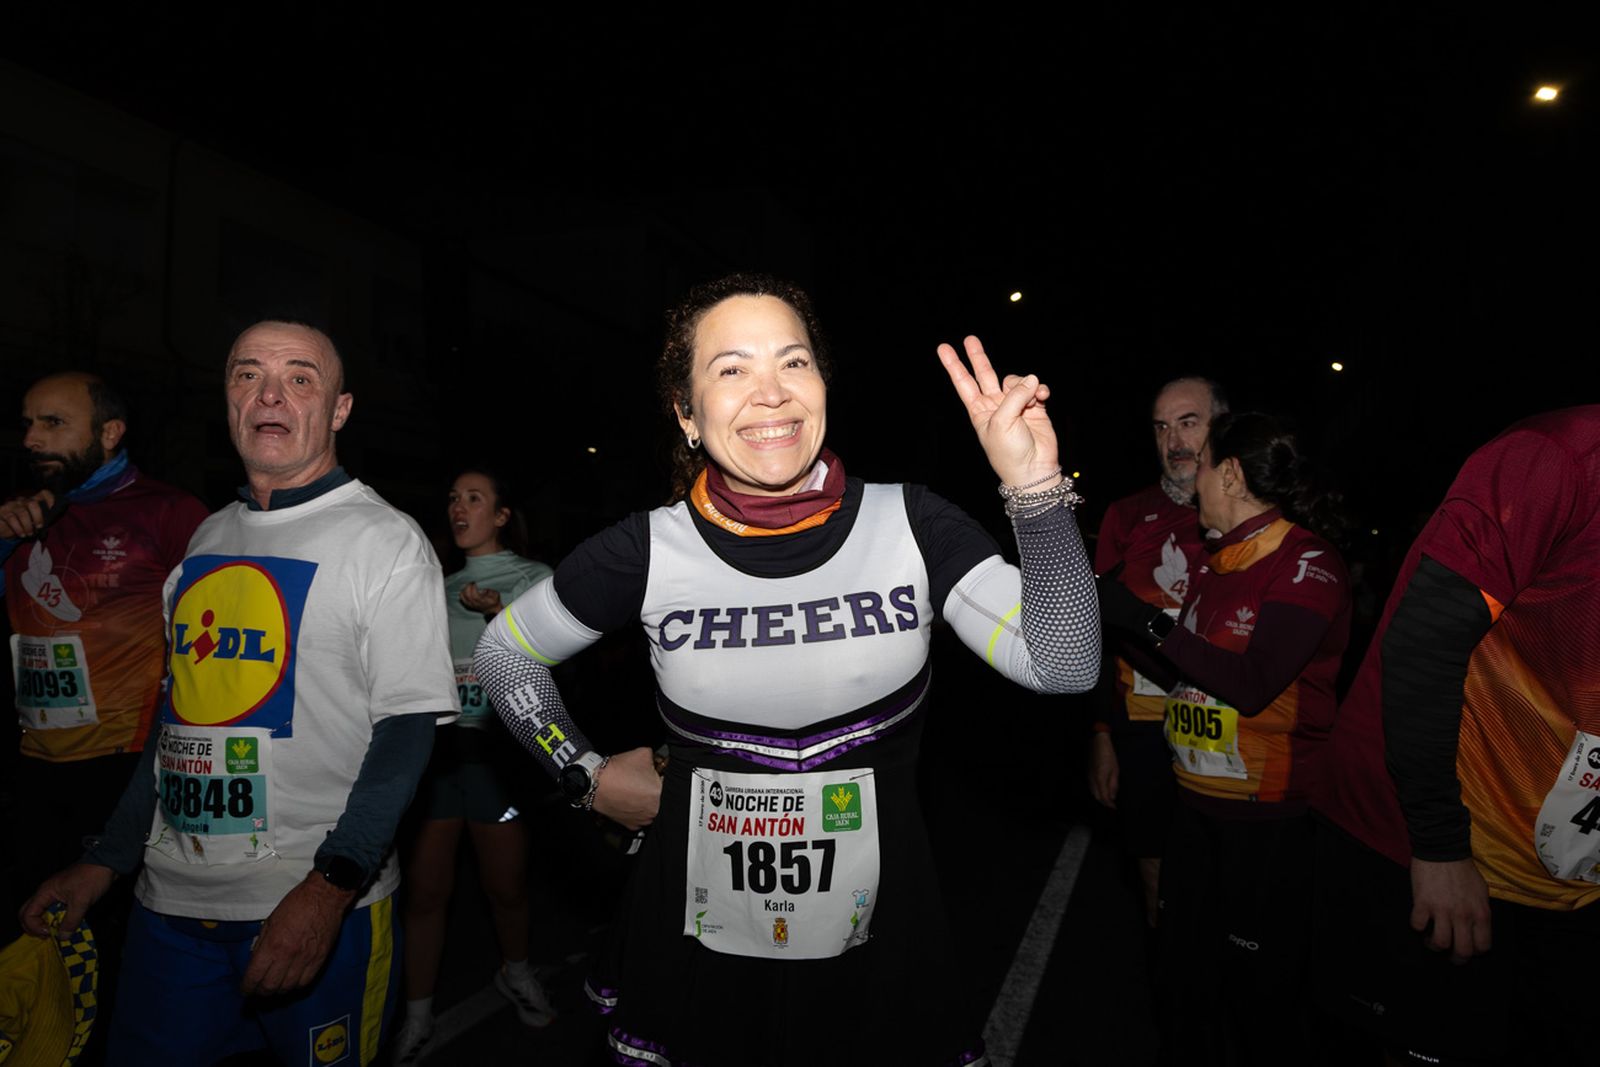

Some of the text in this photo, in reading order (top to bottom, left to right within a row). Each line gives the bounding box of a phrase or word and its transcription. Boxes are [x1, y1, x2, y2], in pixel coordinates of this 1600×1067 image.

[38, 583, 61, 607] 43
[659, 585, 919, 651] CHEERS
[1173, 703, 1222, 739] 1905
[169, 741, 212, 756] NOCHE DE
[161, 755, 212, 774] SAN ANTÓN
[164, 774, 254, 818] 13848
[710, 787, 723, 800] 43
[726, 794, 805, 812] NOCHE DE
[708, 812, 805, 837] SAN ANTÓN
[1570, 796, 1600, 835] 4
[723, 838, 836, 895] 1857
[764, 899, 795, 912] Karla
[1228, 932, 1260, 951] PRO
